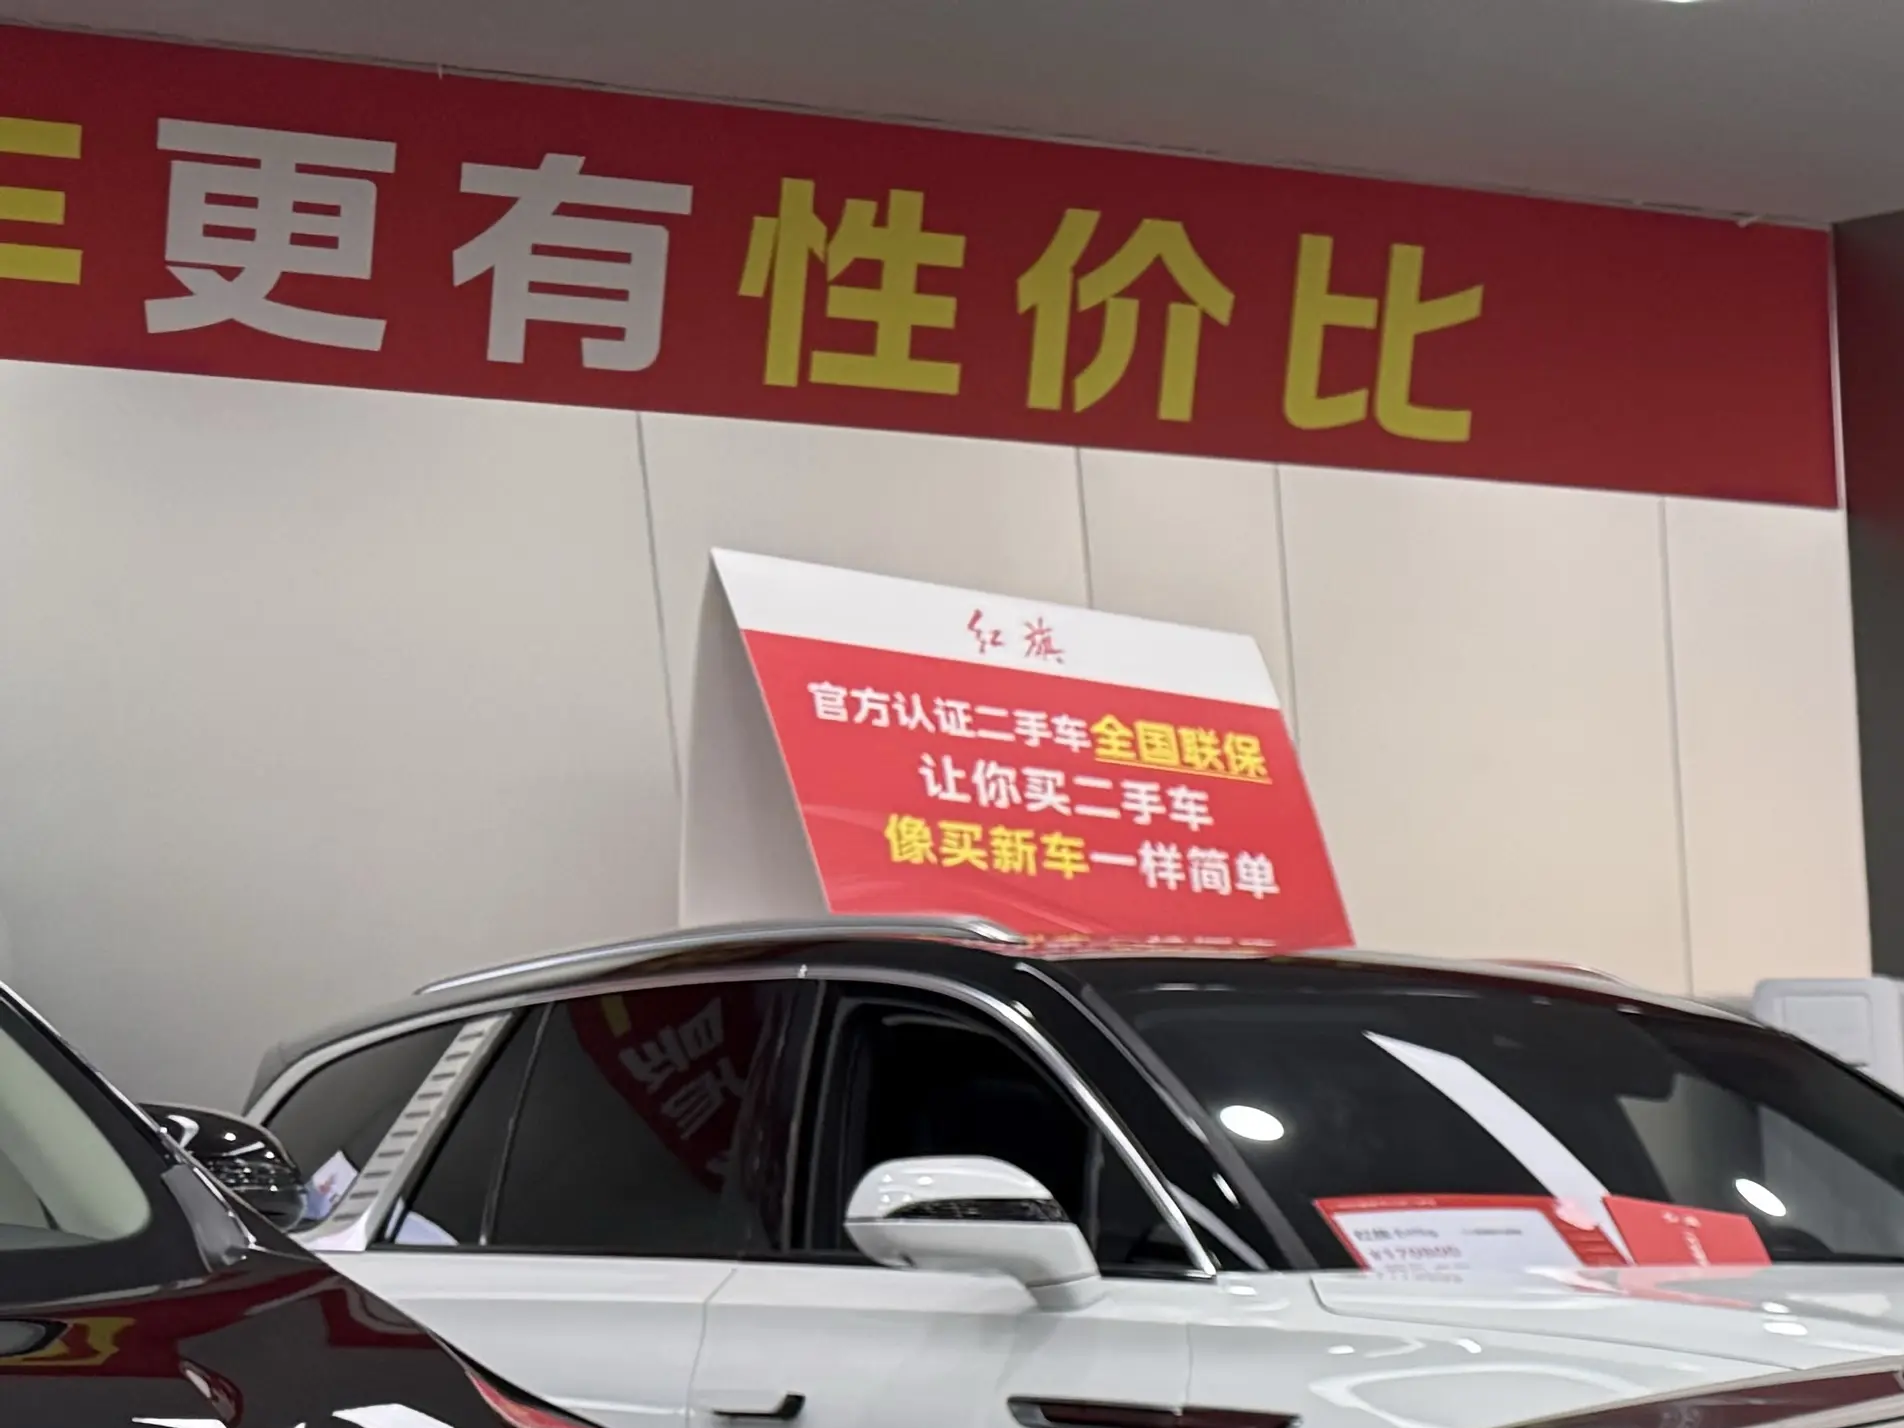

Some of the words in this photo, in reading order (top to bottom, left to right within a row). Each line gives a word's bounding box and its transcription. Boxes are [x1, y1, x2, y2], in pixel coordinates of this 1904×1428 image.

[966, 608, 1064, 663] 红旗
[807, 681, 1269, 778] 官方认证二手车全国联保
[918, 754, 1214, 828] 让你买二手车
[884, 813, 1281, 900] 像买新车一样简单
